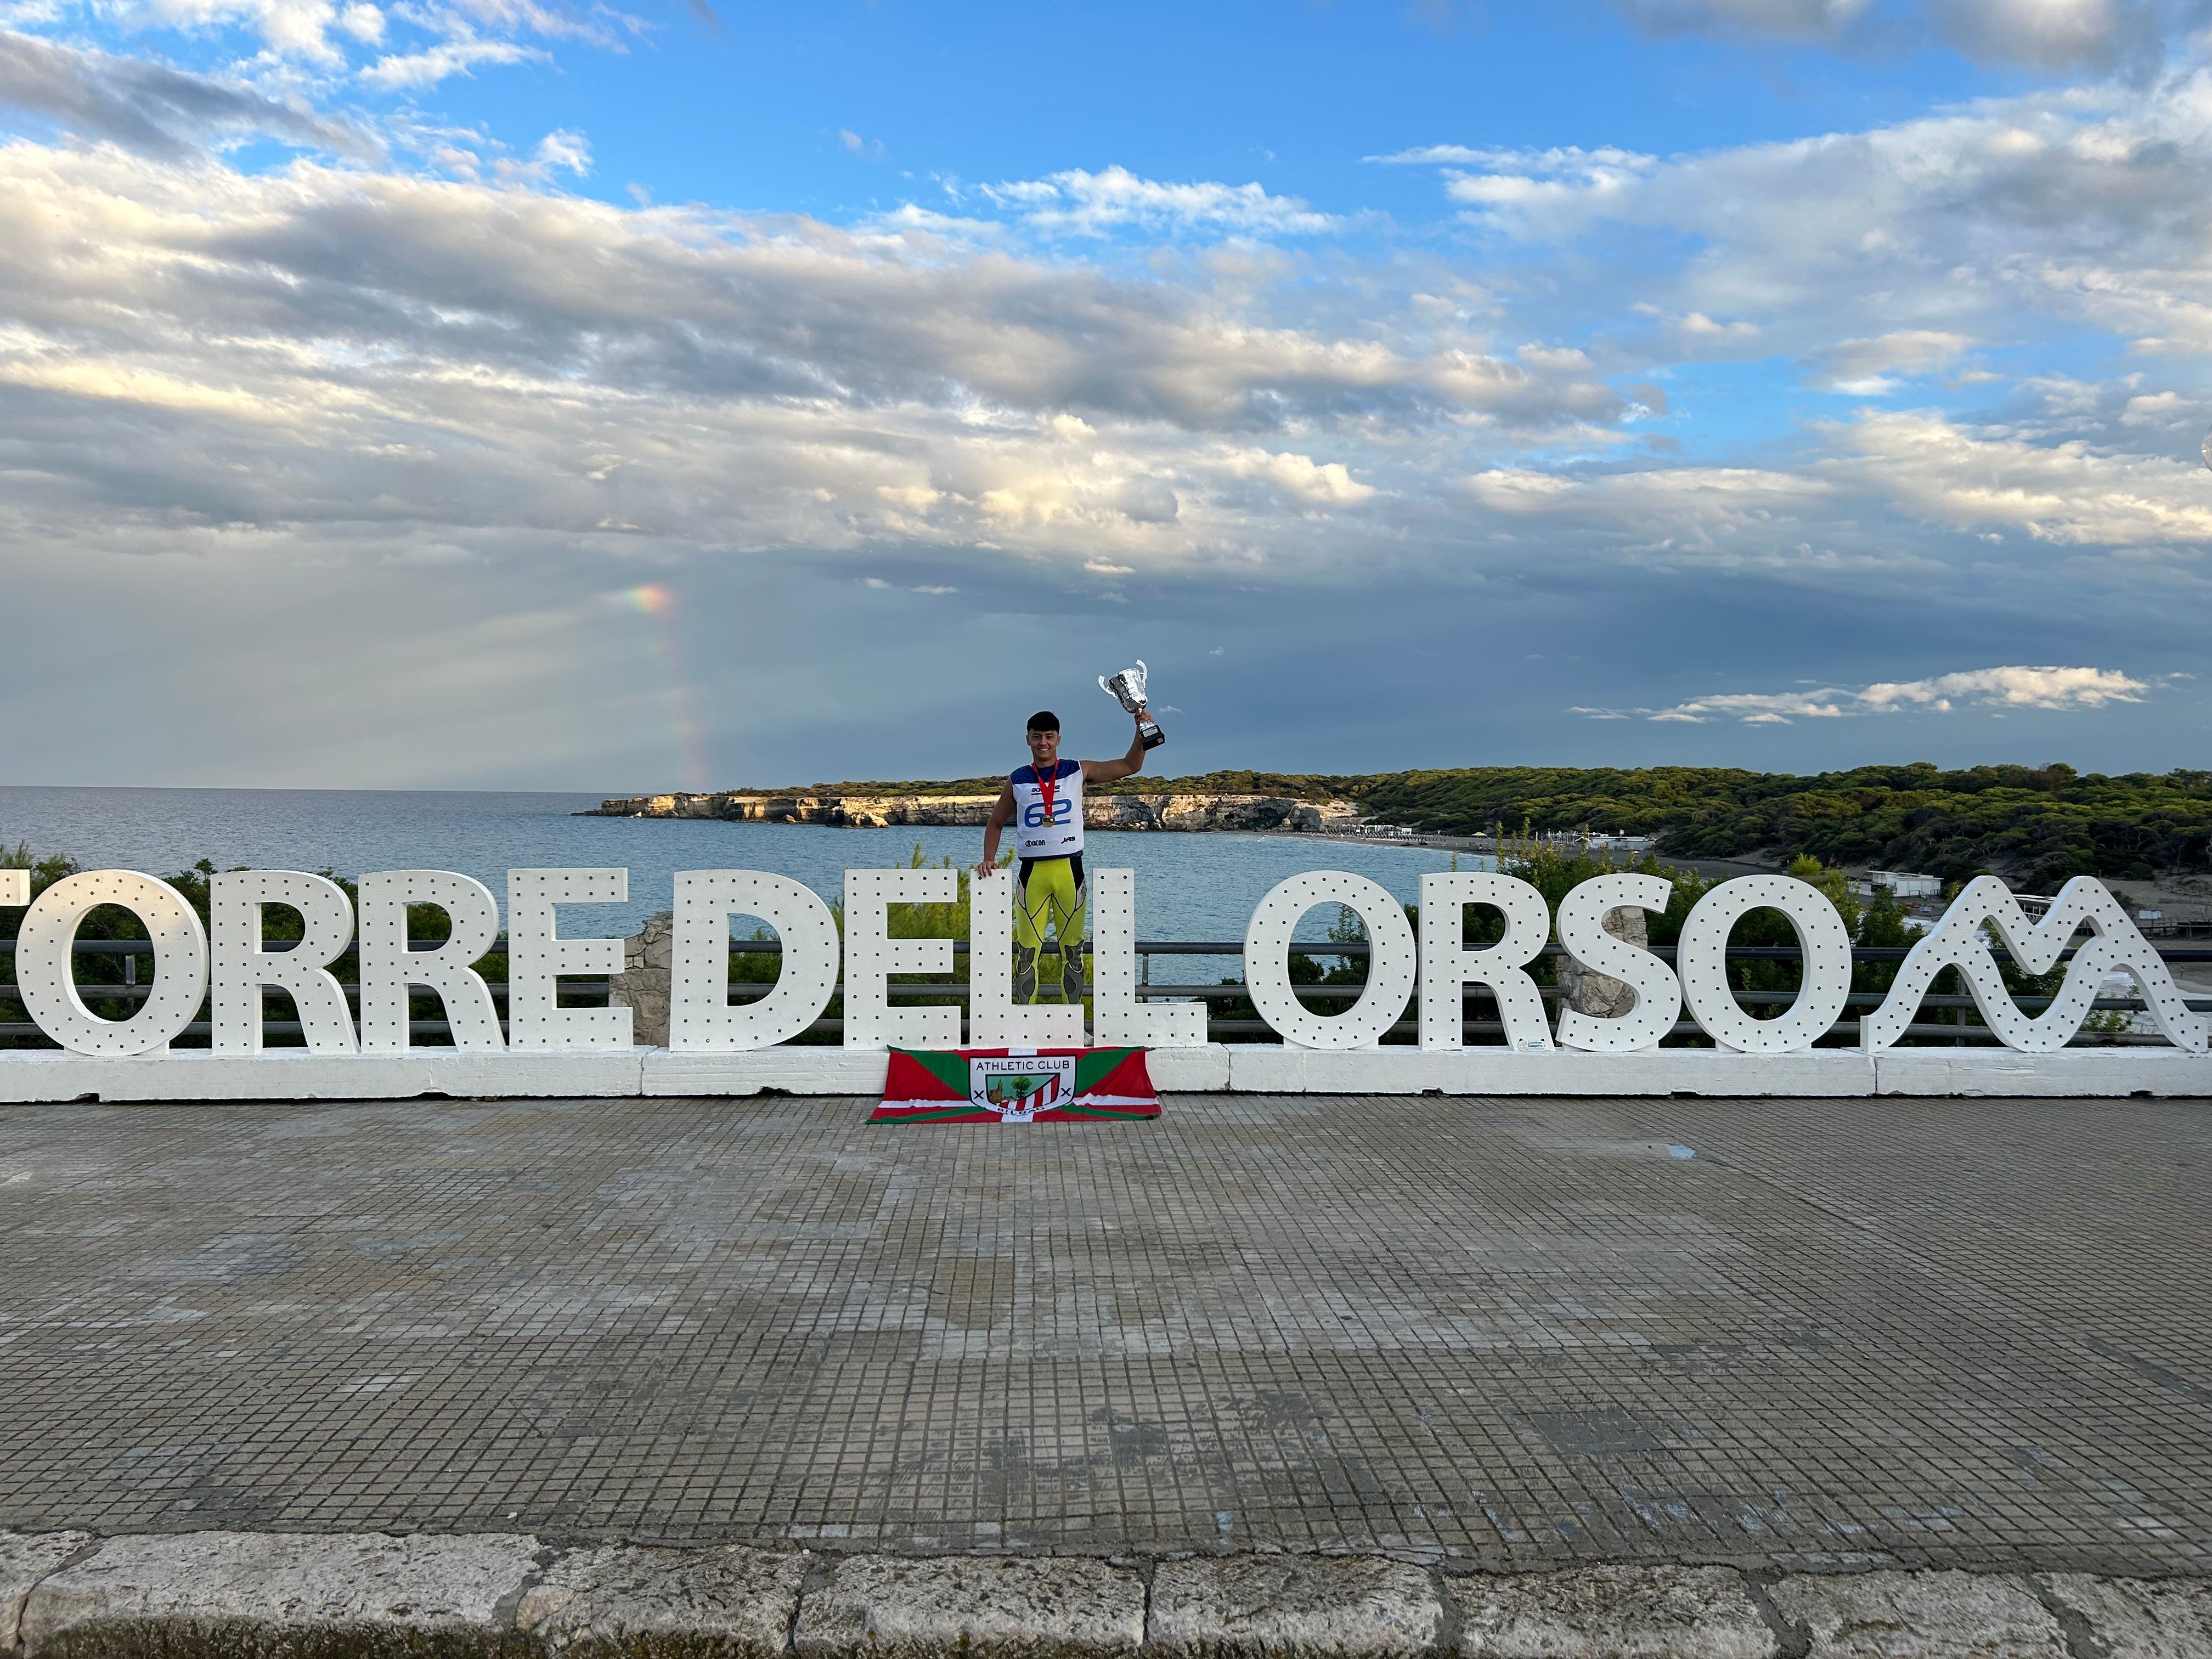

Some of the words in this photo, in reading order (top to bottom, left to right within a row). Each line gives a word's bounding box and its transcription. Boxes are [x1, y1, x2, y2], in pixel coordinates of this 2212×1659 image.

[1024, 799, 1071, 827] 62
[0, 867, 633, 1057] ORRE
[669, 867, 1207, 1053] DELL
[1244, 870, 1852, 1053] ORSO
[976, 1061, 1034, 1070] ATHLETIC
[1037, 1060, 1070, 1069] CLUB
